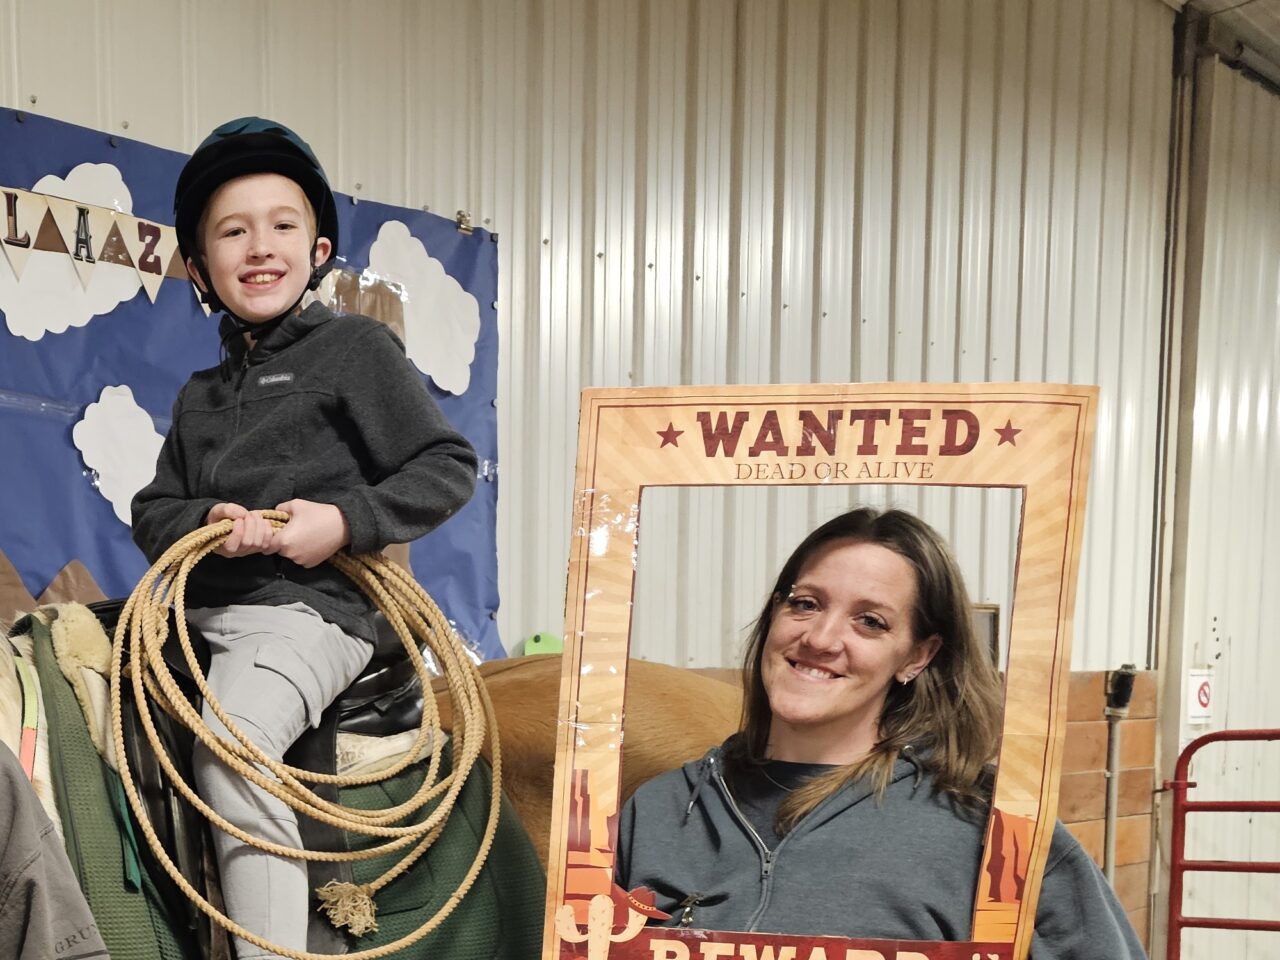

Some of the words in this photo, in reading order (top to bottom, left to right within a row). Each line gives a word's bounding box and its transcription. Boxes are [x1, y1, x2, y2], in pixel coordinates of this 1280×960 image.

[696, 408, 981, 458] WANTED
[734, 462, 807, 480] DEAD
[814, 462, 850, 480] OR
[857, 461, 934, 480] ALIVE
